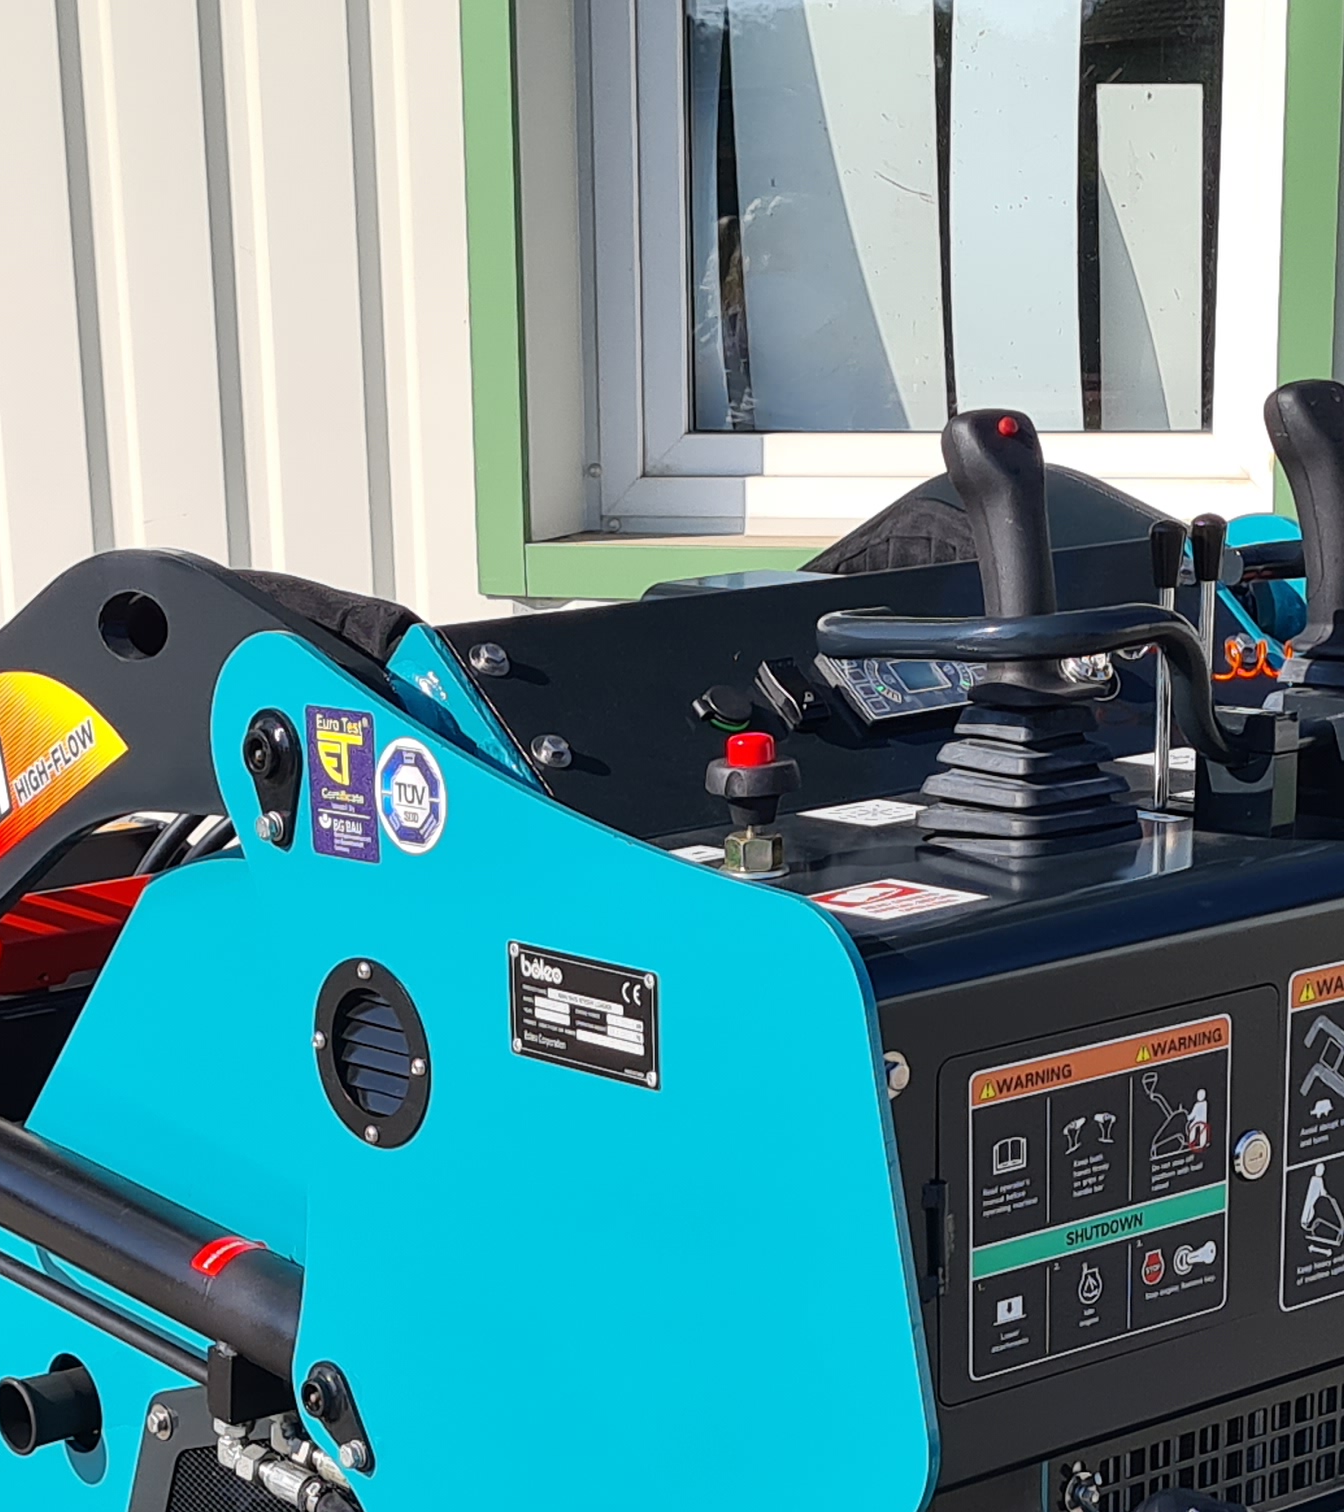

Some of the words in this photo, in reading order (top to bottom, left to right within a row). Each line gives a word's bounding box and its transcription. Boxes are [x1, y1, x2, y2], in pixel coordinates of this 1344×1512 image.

[316, 714, 339, 730] Euro
[14, 719, 95, 805] HIGH-FLOW
[395, 781, 426, 806] TÜV
[1151, 1028, 1223, 1058] WARNING
[996, 1063, 1073, 1095] WARNING
[1066, 1212, 1143, 1246] SHUTDOWN
